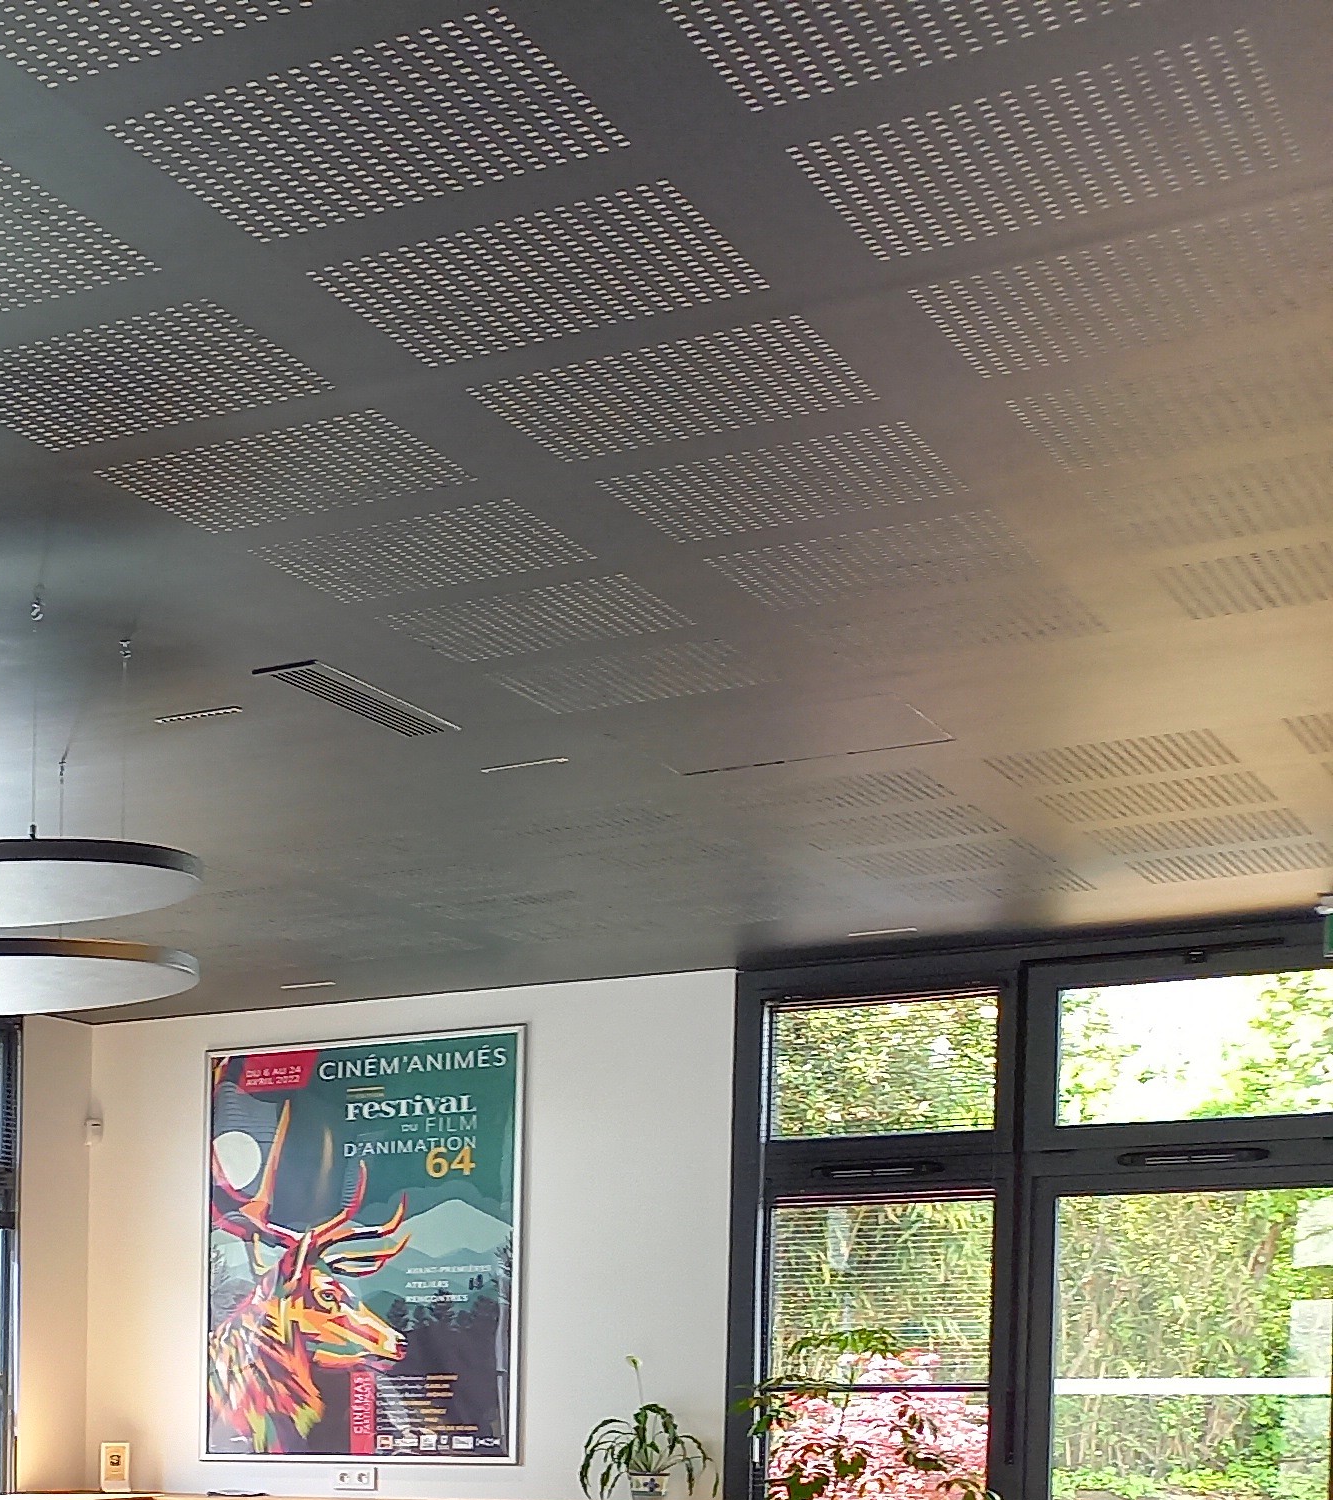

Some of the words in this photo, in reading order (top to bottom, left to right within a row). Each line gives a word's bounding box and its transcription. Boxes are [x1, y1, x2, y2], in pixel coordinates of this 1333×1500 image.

[319, 1044, 508, 1081] CINÉM'ANIMÉS
[425, 1114, 478, 1133] FILM
[343, 1135, 477, 1158] D'ANIMATION
[425, 1145, 476, 1178] 64
